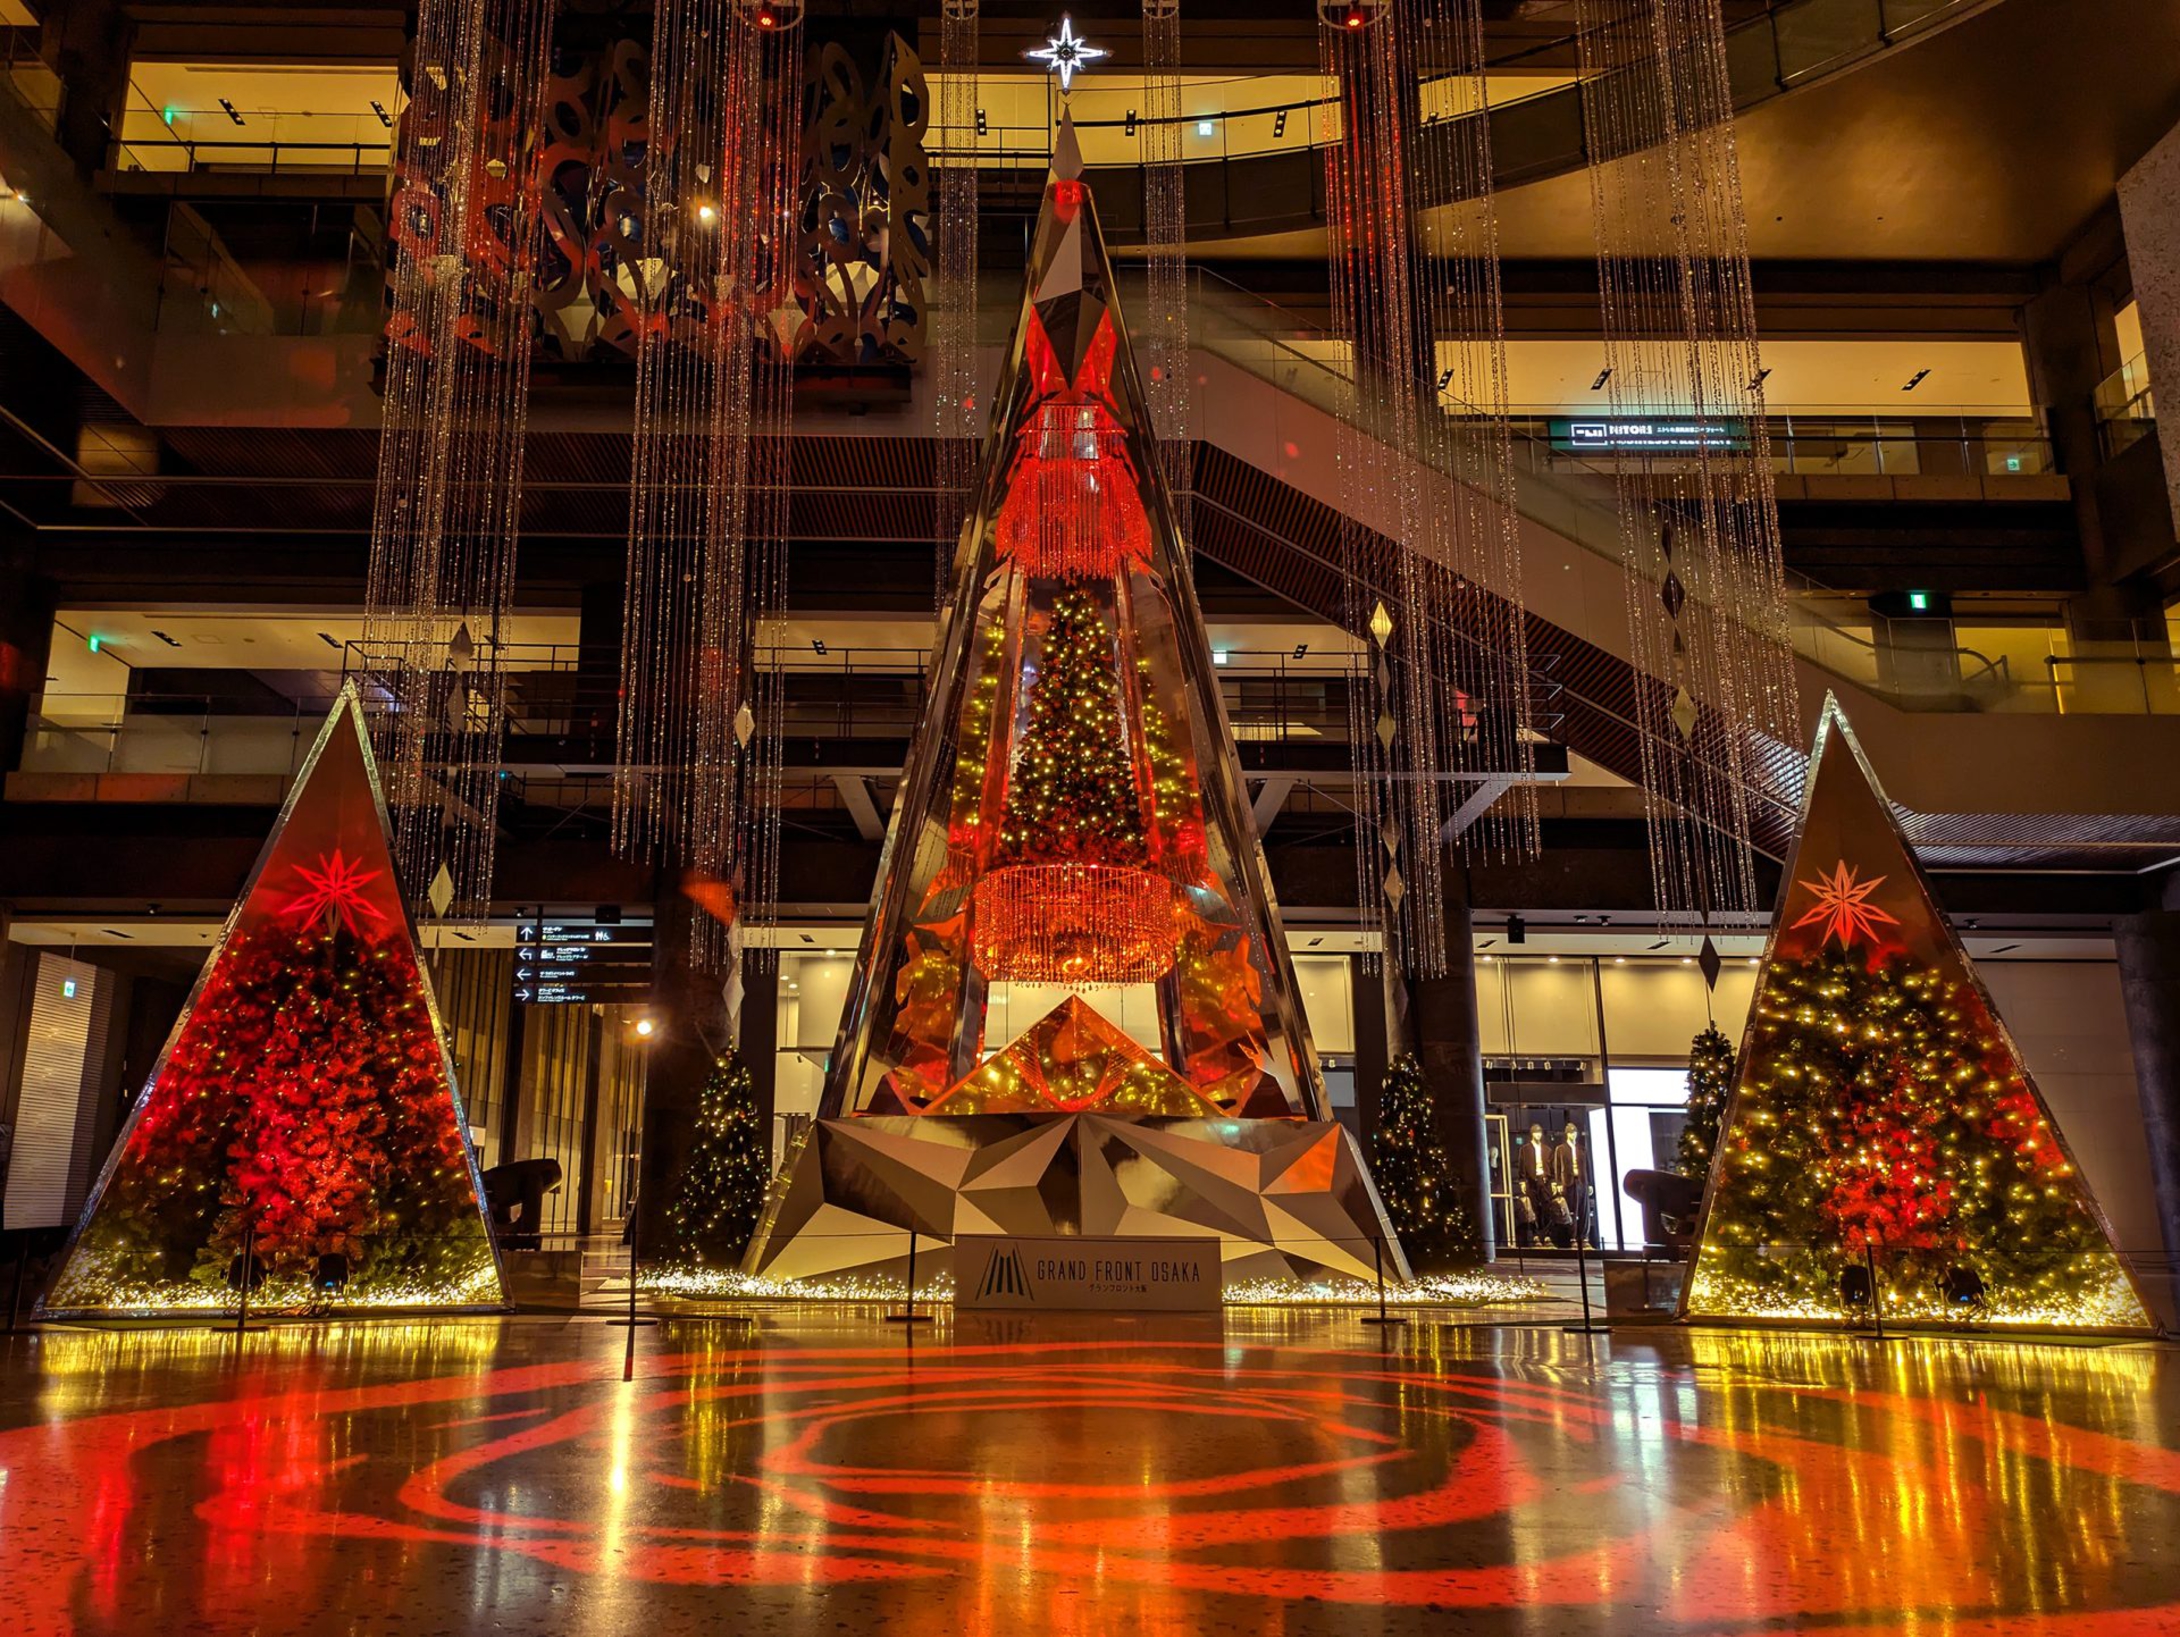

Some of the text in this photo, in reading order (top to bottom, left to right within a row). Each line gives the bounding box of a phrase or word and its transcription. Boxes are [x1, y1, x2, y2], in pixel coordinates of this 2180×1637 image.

[1037, 1260, 1200, 1282] GRAND FRONT OSAKA
[1090, 1284, 1147, 1293] グランフロント大阪
